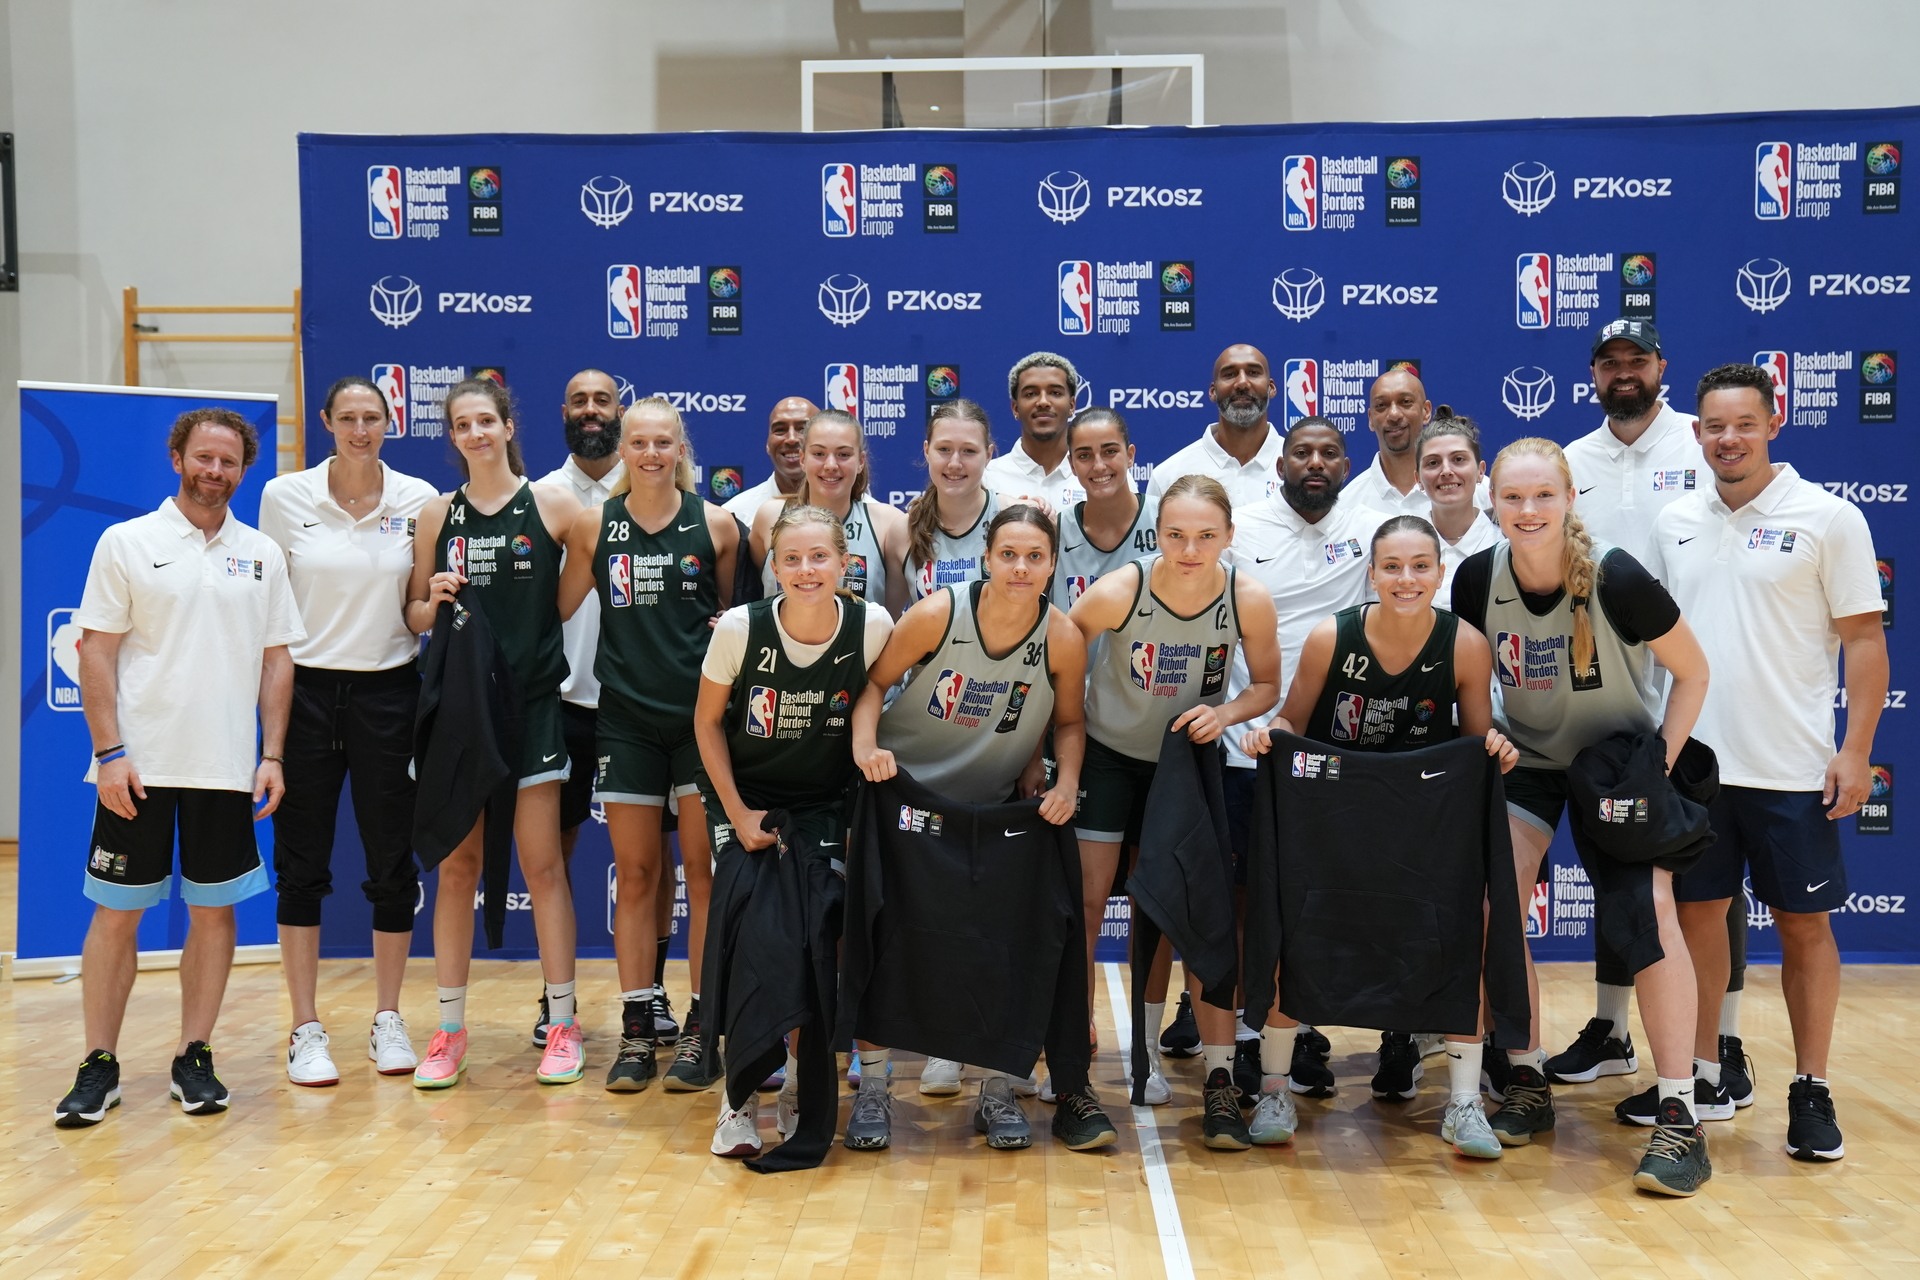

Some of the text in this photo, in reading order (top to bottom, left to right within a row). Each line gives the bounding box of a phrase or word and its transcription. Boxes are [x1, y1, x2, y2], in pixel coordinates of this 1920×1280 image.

[1797, 142, 1857, 162] Basketball
[860, 164, 916, 182] Basketball
[1322, 156, 1377, 174] Basketball
[1797, 162, 1840, 180] Without
[405, 167, 460, 184] Basketball
[1322, 175, 1362, 193] Without
[406, 185, 446, 202] Without
[861, 182, 901, 200] Without
[1796, 181, 1841, 199] Borders
[1869, 182, 1894, 196] FIBA
[861, 200, 903, 218] Borders
[928, 204, 953, 216] FIBA
[1322, 193, 1365, 211] Borders
[1391, 197, 1415, 209] FIBA
[1760, 202, 1776, 214] NBA
[1796, 199, 1830, 220] Europe
[406, 203, 449, 220] Borders
[473, 206, 498, 219] FIBA
[1288, 214, 1304, 226] NBA
[374, 221, 390, 234] NBA
[828, 220, 844, 232] NBA
[862, 218, 893, 238] Europe
[1322, 211, 1354, 231] Europe
[408, 220, 440, 240] Europe
[1097, 261, 1152, 279] Basketball
[1556, 253, 1613, 272] Basketball
[645, 266, 700, 284] Basketball
[1556, 272, 1597, 290] Without
[646, 284, 686, 302] Without
[1097, 280, 1138, 297] Without
[1097, 298, 1139, 315] Borders
[1165, 302, 1189, 313] FIBA
[1556, 290, 1599, 309] Borders
[1626, 294, 1650, 306] FIBA
[646, 302, 688, 320] Borders
[713, 306, 737, 318] FIBA
[1522, 311, 1537, 324] NBA
[1556, 309, 1589, 329] Europe
[613, 321, 629, 333] NBA
[646, 320, 678, 340] Europe
[1064, 318, 1079, 330] NBA
[1098, 316, 1129, 336] Europe
[1323, 360, 1379, 377] Basketball
[1793, 351, 1852, 370] Basketball
[410, 366, 464, 383] Basketball
[863, 364, 918, 382] Basketball
[1793, 370, 1836, 388] Without
[863, 383, 903, 400] Without
[1323, 378, 1364, 396] Without
[1323, 396, 1365, 414] Borders
[1793, 389, 1838, 407] Borders
[1865, 392, 1890, 405] FIBA
[864, 401, 905, 418] Borders
[1793, 407, 1826, 428] Europe
[411, 420, 442, 440] Europe
[864, 418, 895, 439] Europe
[607, 520, 630, 542] 28
[846, 521, 863, 541] 37
[468, 535, 506, 549] Basketball
[1134, 528, 1158, 552] 40
[468, 548, 495, 561] Without
[633, 553, 673, 566] Basketball
[468, 561, 497, 573] Borders
[514, 561, 531, 570] FIBA
[937, 556, 975, 571] Basketball
[633, 567, 663, 579] Without
[936, 571, 965, 584] Without
[634, 579, 664, 592] Borders
[635, 592, 658, 606] Europe
[1159, 643, 1201, 658] Basketball
[1525, 635, 1565, 652] Basketball
[757, 646, 777, 674] 21
[1023, 642, 1043, 667] 36
[1525, 650, 1556, 665] Without
[1158, 657, 1187, 670] Without
[1342, 652, 1369, 682] 42
[1525, 664, 1558, 678] Borders
[1155, 670, 1187, 684] Borders
[1526, 678, 1552, 691] Europe
[966, 678, 1010, 694] Basketball
[1152, 684, 1177, 698] Europe
[55, 687, 80, 704] NBA
[780, 690, 824, 704] Basketball
[962, 690, 994, 706] Without
[779, 704, 812, 717] Without
[929, 705, 942, 716] NBA
[958, 702, 991, 717] Borders
[750, 724, 762, 734] NBA
[778, 717, 811, 728] Borders
[826, 718, 845, 726] FIBA
[953, 713, 980, 728] Europe
[776, 728, 802, 740] Europe
[1335, 728, 1347, 738] NBA
[1410, 726, 1428, 736] FIBA
[1862, 804, 1887, 817] FIBA
[1554, 900, 1595, 918] Borders
[1100, 922, 1128, 940] urope
[1553, 918, 1586, 939] Europe
